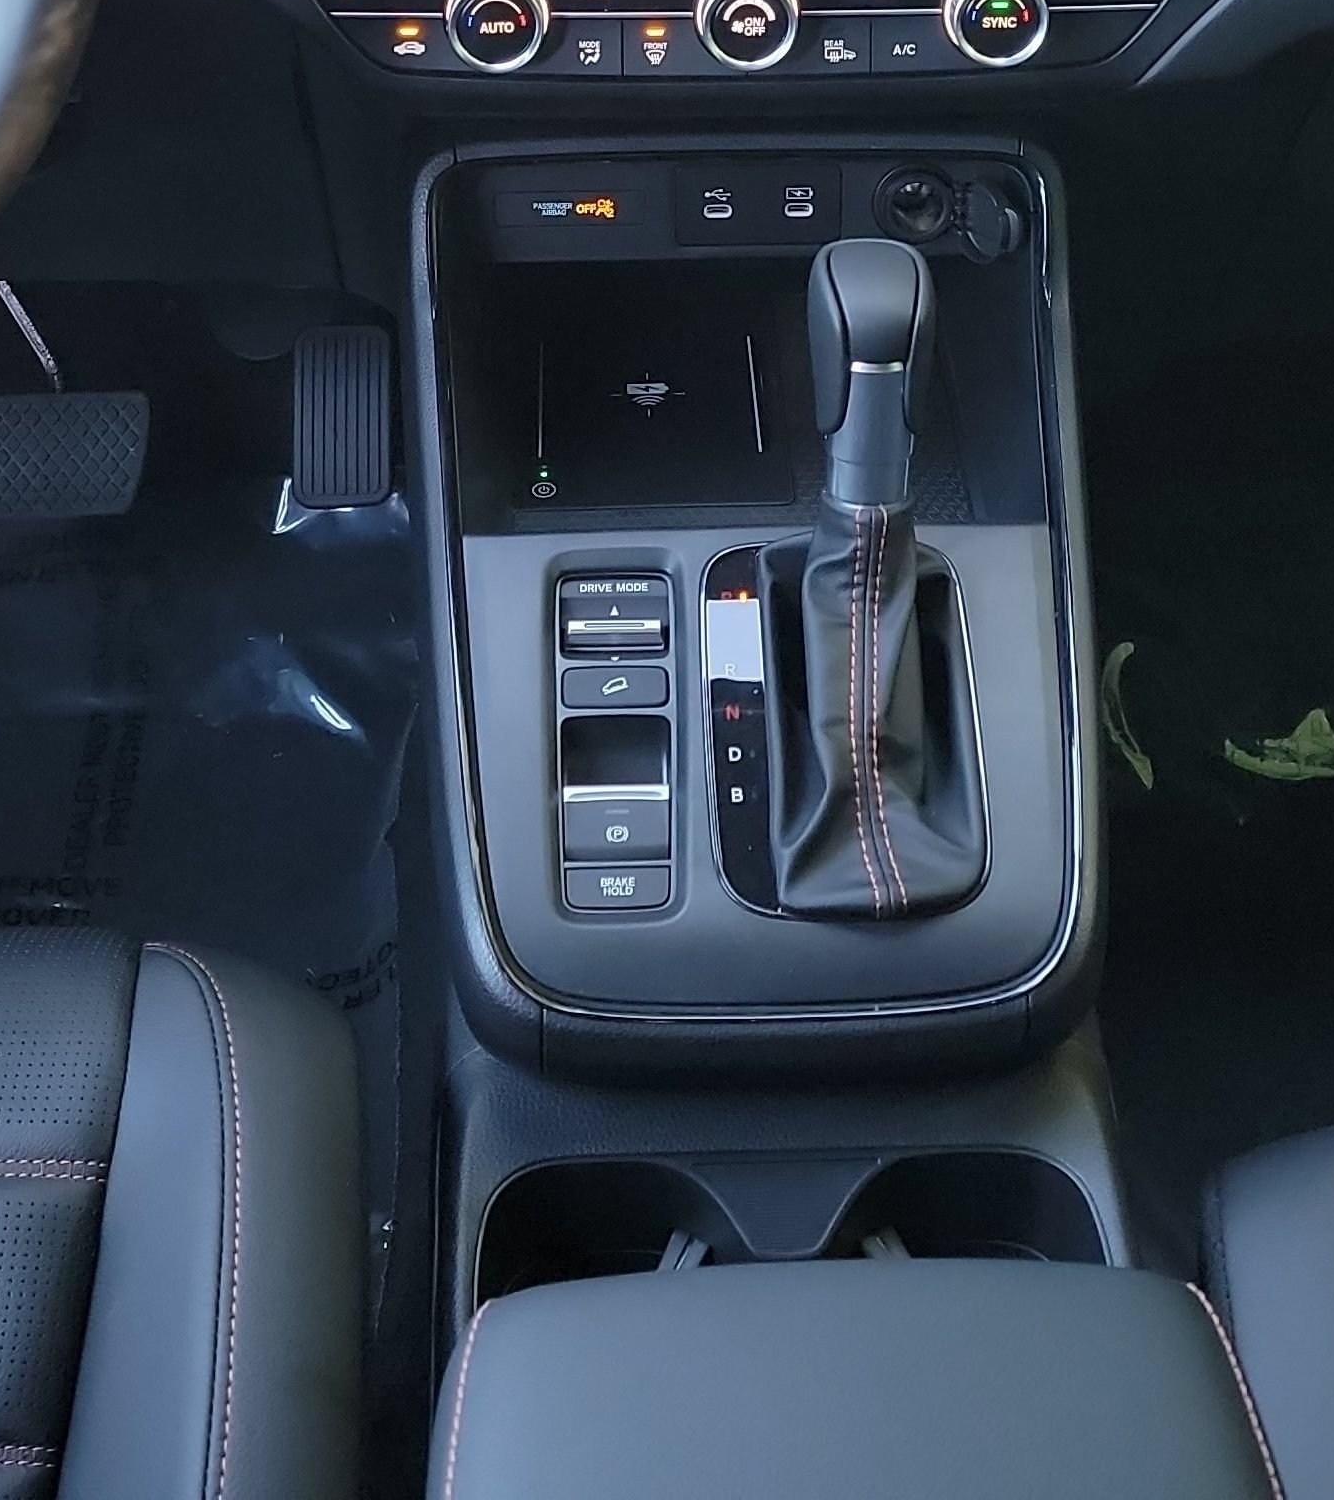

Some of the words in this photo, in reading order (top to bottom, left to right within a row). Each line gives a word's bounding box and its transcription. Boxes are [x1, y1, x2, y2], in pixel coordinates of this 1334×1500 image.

[480, 21, 515, 34] AUTO
[744, 17, 766, 27] ON/
[982, 17, 1017, 29] SYNC
[744, 27, 766, 36] OFF
[579, 41, 600, 49] MODE
[644, 42, 667, 50] FRONT
[892, 44, 916, 55] A/C
[533, 202, 573, 210] PASSENGER
[576, 203, 596, 214] OFF
[579, 583, 612, 593] DRIVE
[616, 582, 649, 592] MODE
[724, 663, 736, 676] R
[725, 705, 740, 720] N
[728, 747, 742, 762] D
[731, 788, 744, 802] B
[601, 876, 635, 887] BRAKE
[603, 886, 634, 896] HOLD
